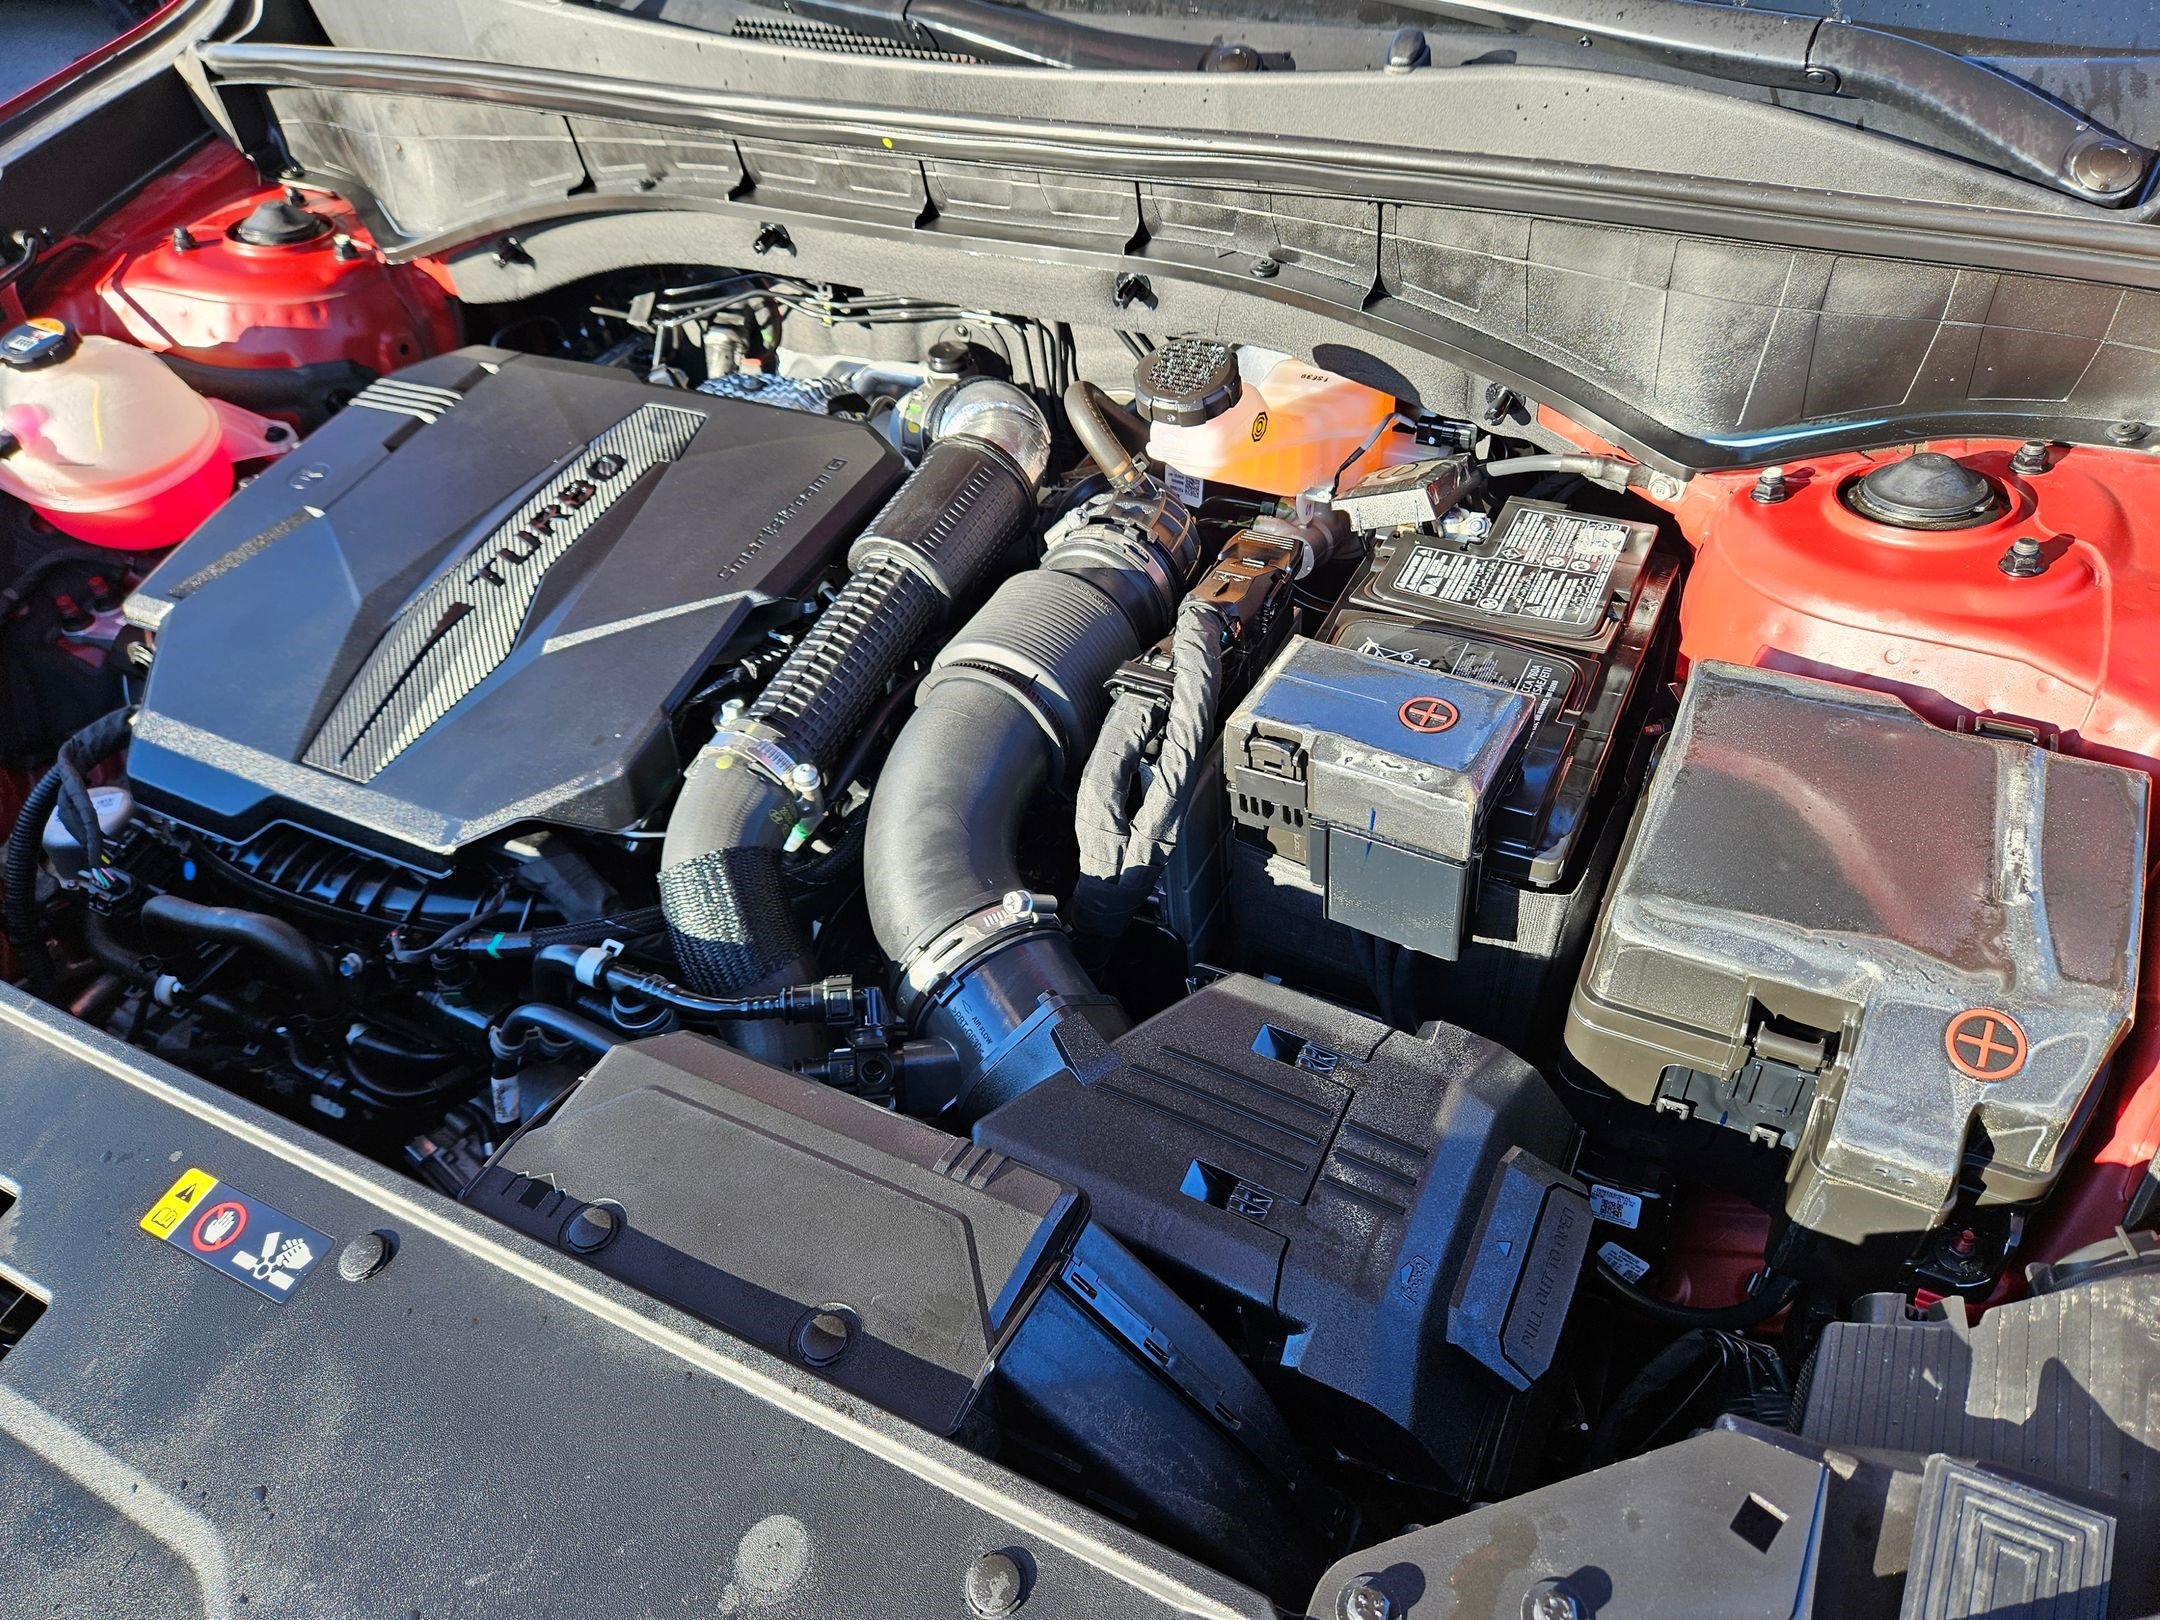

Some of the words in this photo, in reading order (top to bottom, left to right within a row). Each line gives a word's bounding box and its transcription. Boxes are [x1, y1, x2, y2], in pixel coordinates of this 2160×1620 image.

[468, 454, 628, 588] TURBO
[717, 473, 832, 582] Smartstream
[824, 457, 849, 472] G
[1520, 680, 1534, 694] CCA
[1527, 664, 1543, 682] 760A
[971, 1016, 982, 1028] AIR
[977, 1023, 993, 1045] FLOW
[1554, 1206, 1575, 1248] OPEN
[1545, 1248, 1561, 1270] TO
[1536, 1270, 1555, 1306] OUT
[1521, 1310, 1545, 1350] PULL
